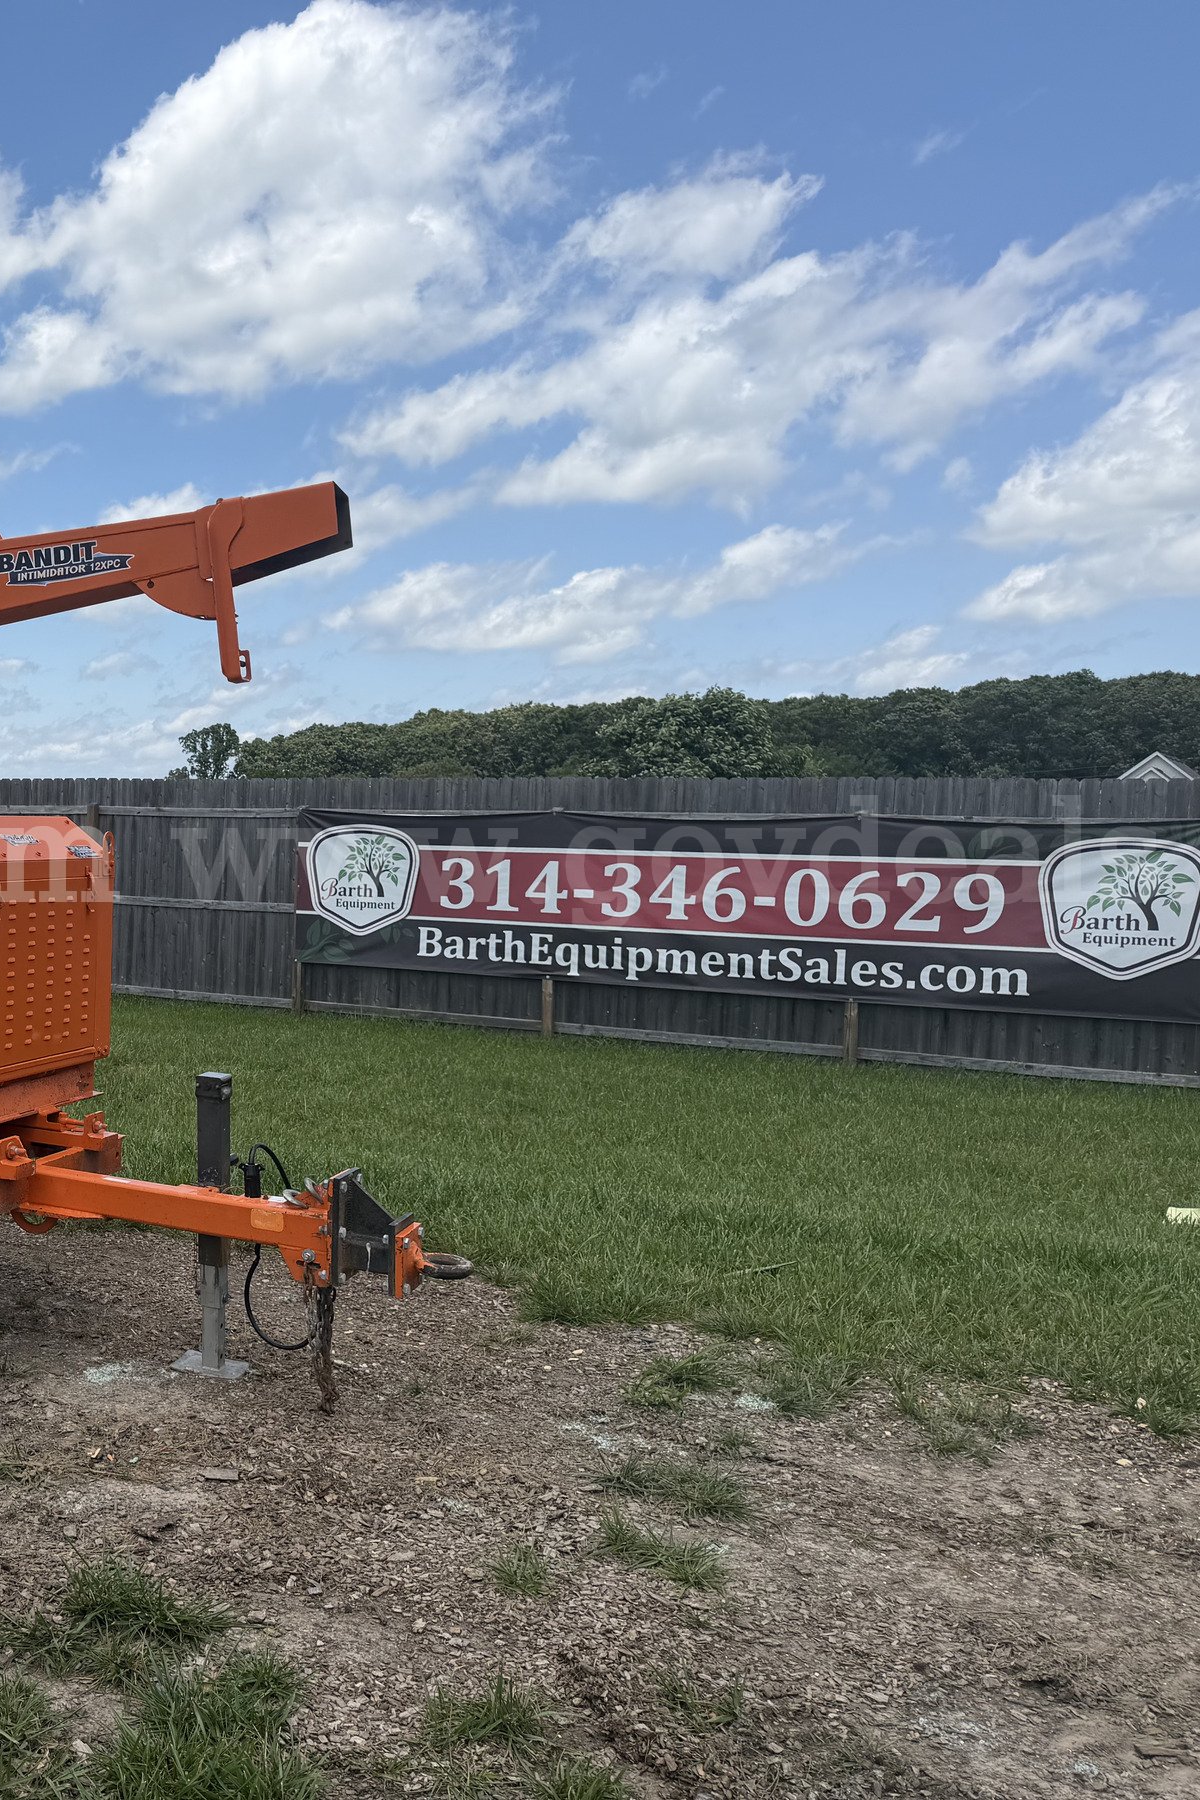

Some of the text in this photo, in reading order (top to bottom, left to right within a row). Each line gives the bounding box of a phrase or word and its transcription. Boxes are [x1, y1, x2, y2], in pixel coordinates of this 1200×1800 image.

[17, 559, 121, 581] INTIMIDATOR 12XPC
[320, 877, 374, 902] Barth
[439, 858, 1006, 934] 314-346-0629
[335, 897, 396, 911] Equipment
[1059, 905, 1141, 935] Barth
[1082, 932, 1177, 948] Equipment
[416, 926, 1030, 997] BarthEquipmentSales.com
